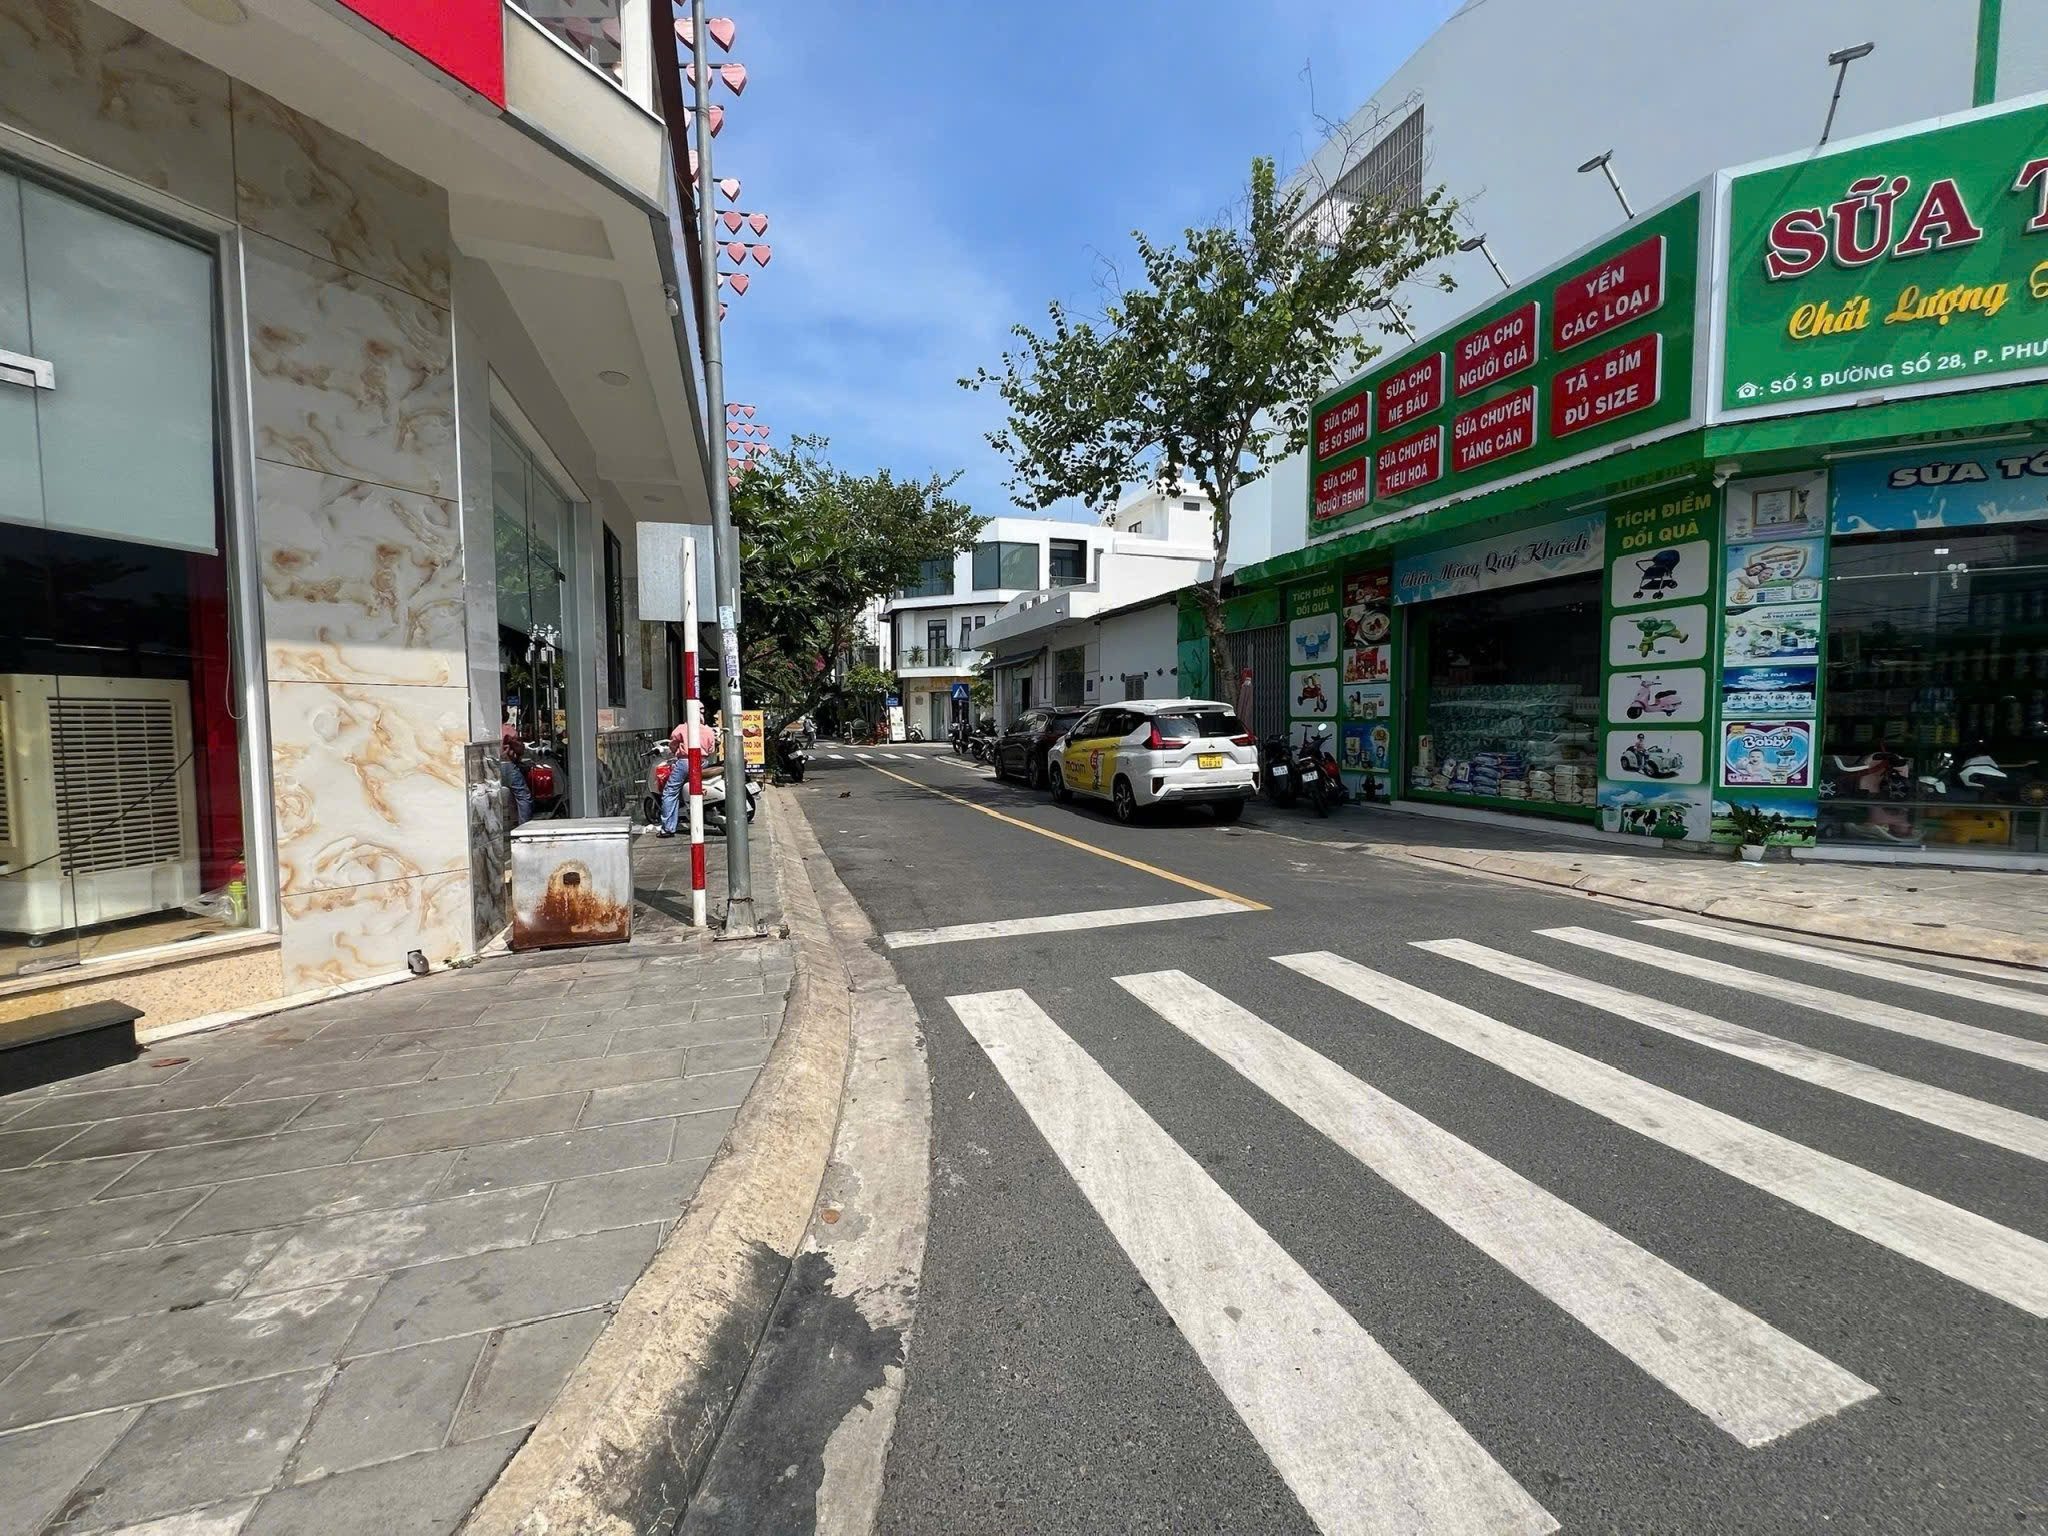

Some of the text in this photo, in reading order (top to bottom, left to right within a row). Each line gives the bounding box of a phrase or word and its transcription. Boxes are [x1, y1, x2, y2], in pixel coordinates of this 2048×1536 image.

[1765, 175, 1983, 281] SỮA
[1586, 266, 1625, 298] YẾN
[1561, 285, 1650, 341] CÁC LOẠI
[1789, 283, 2010, 340] Chất Lượng
[1465, 318, 1523, 360] SỮA CHO
[1386, 365, 1432, 400] SỮA CHO
[1459, 340, 1527, 390] NGƯỜI GIÀ
[1566, 368, 1588, 394] TÃ
[1605, 350, 1641, 380] BỈM
[1770, 372, 1797, 393] SỐ
[1802, 377, 1812, 389] 3
[1820, 363, 1894, 387] ĐƯỜNG
[1901, 352, 1932, 376] SỐ
[1937, 354, 1967, 370] 28,
[1973, 349, 1993, 365] P.
[1324, 403, 1359, 432] SỮA CHO
[1388, 390, 1428, 423] MẸ BẦU
[1455, 395, 1531, 439] SỮA CHUYÊN
[1565, 383, 1639, 426] ĐỦ SIZE
[1319, 422, 1364, 455] BÉ SƠ SINH
[1380, 434, 1437, 470] SỮA CHUYÊN
[1461, 427, 1522, 463] TĂNG CÂN
[1323, 468, 1358, 492] SỮA CHO
[1386, 470, 1406, 489] TIÊU
[1889, 461, 1988, 488] SỮA
[1316, 487, 1364, 515] NGƯỜI BỆNH
[1615, 491, 1711, 528] TÍCH ĐIỂM
[1622, 519, 1699, 549] ĐỔI QUÀ
[1400, 534, 1589, 588] Chào Mừng Quý Khách
[1293, 590, 1311, 601] TÍCH
[1312, 599, 1329, 612] QUÀ
[1742, 735, 1793, 749] Bobby
